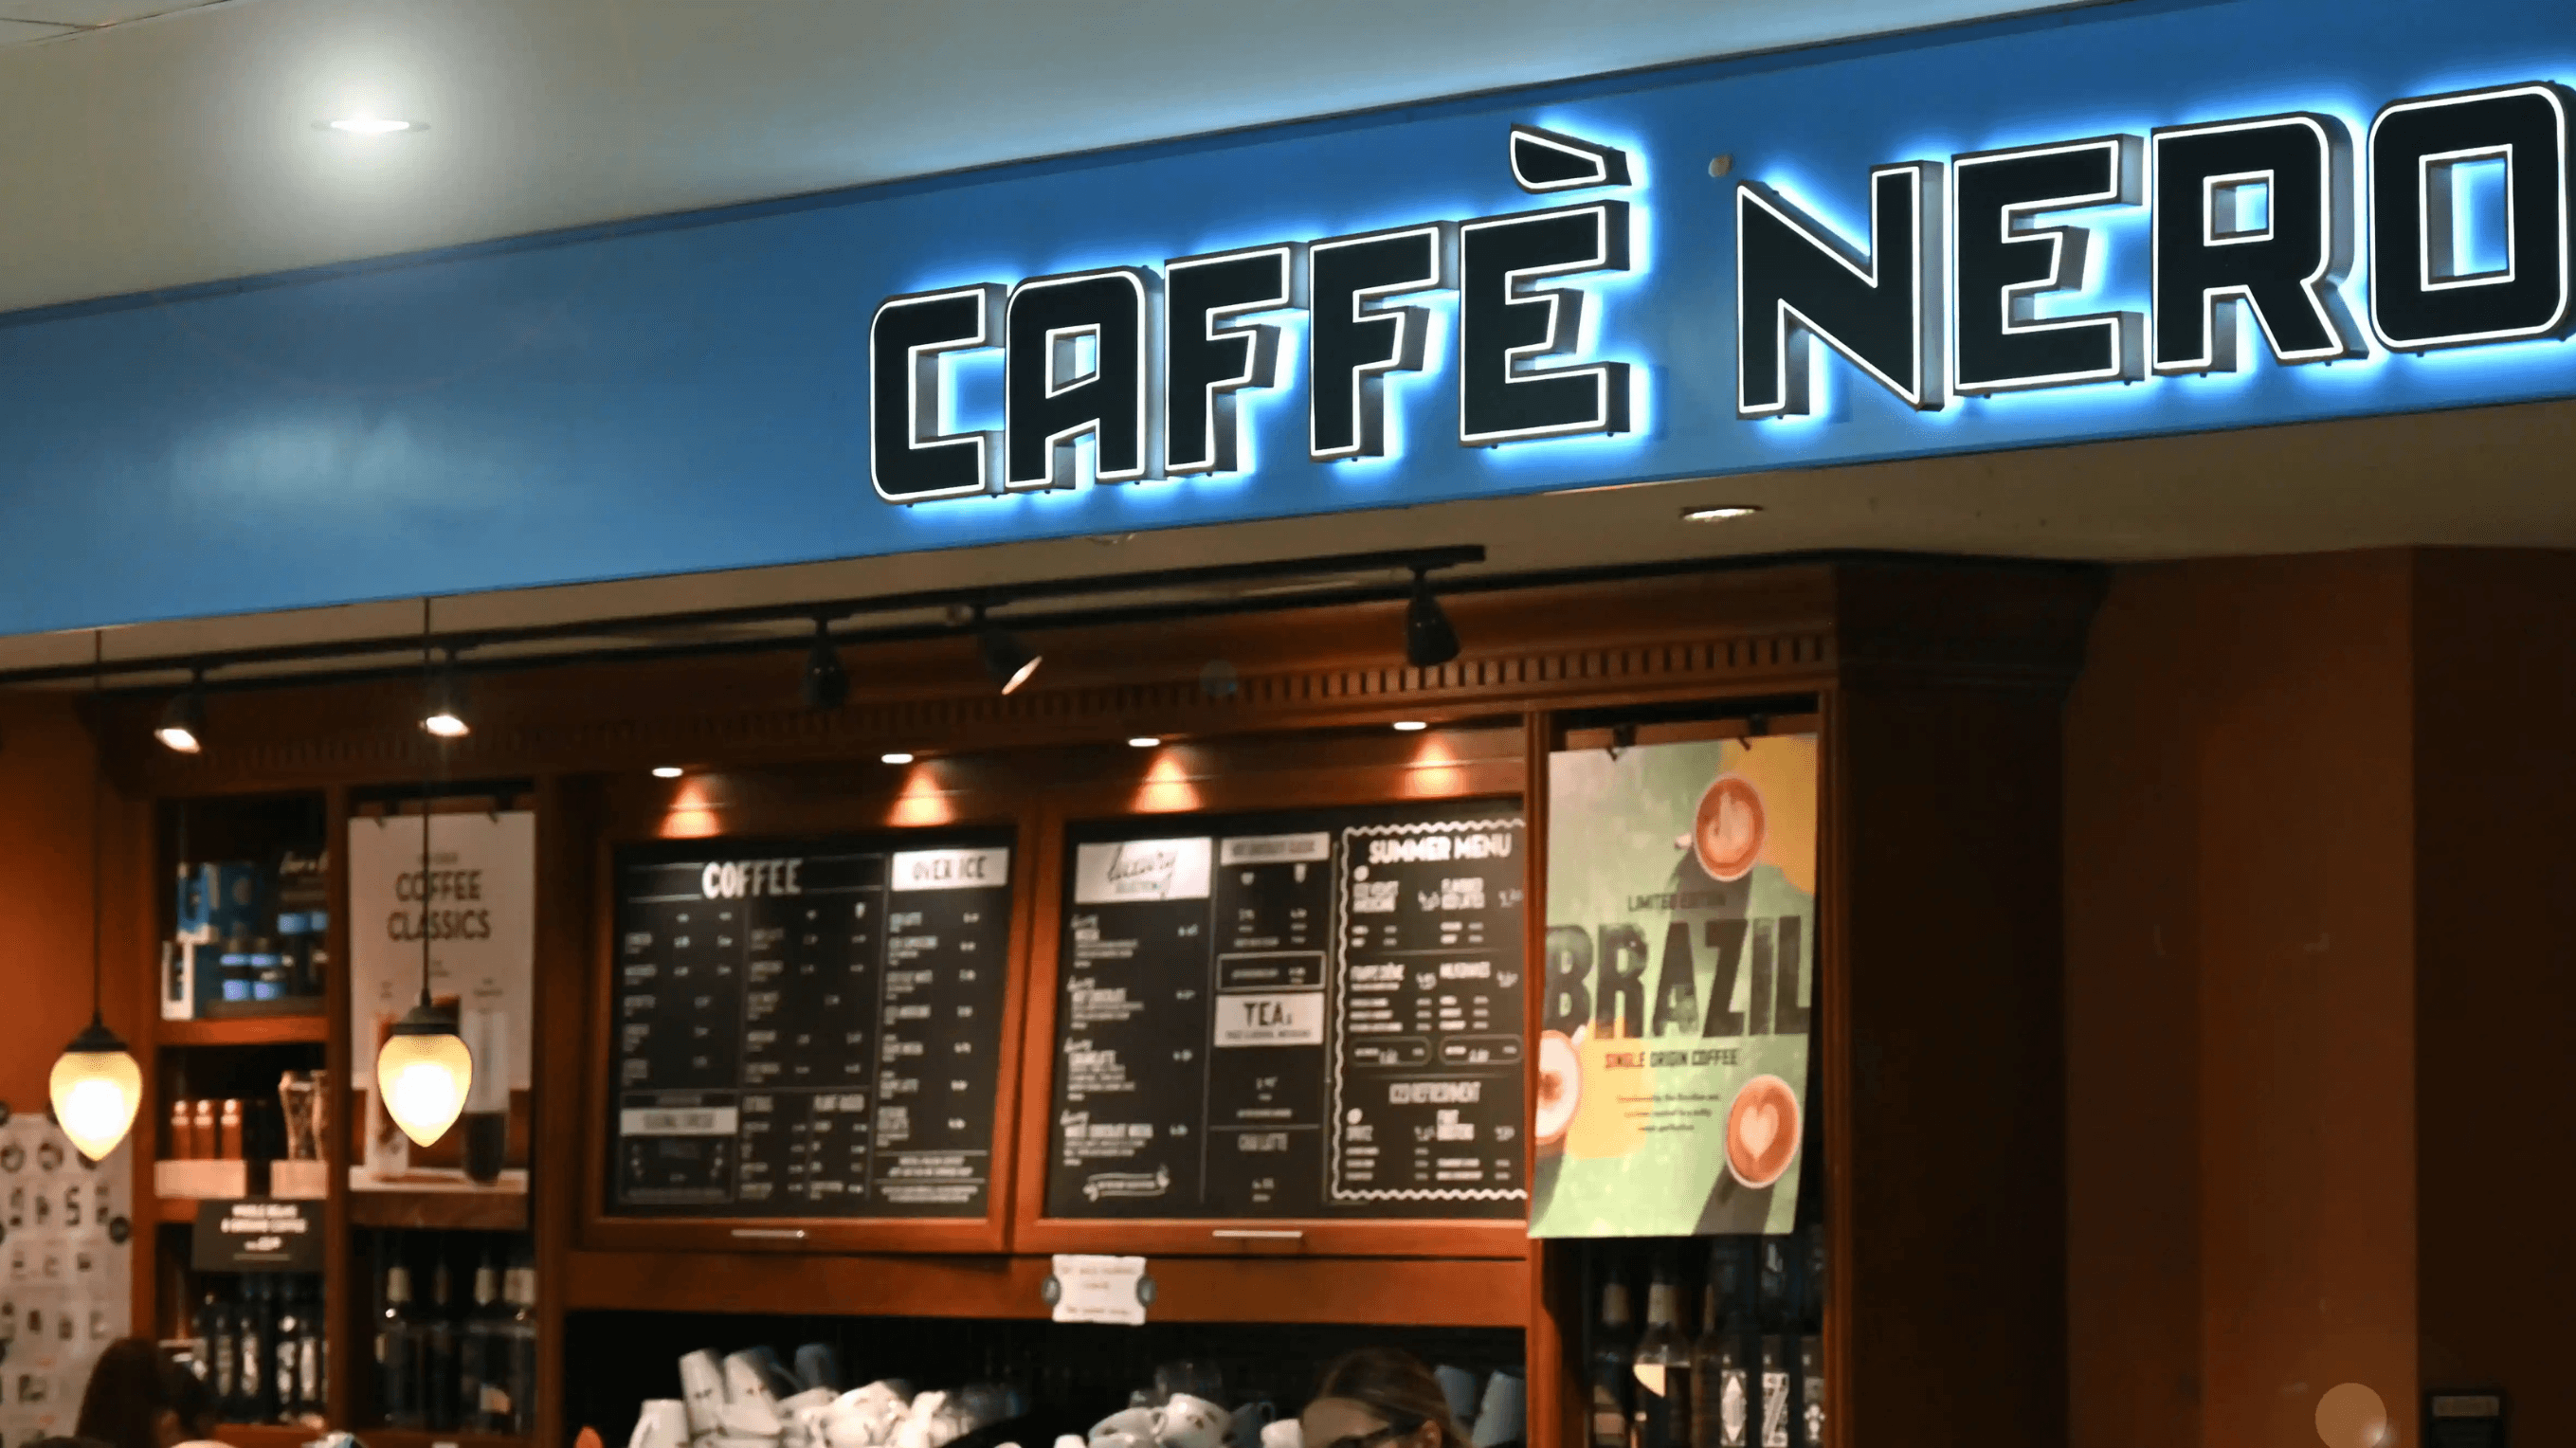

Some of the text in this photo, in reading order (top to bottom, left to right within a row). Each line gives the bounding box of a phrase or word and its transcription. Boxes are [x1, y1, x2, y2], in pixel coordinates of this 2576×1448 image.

[870, 81, 2576, 506] CAFFÈ NERO
[1368, 832, 1513, 864] SUMMER MENU
[701, 857, 804, 898] COFFEE
[959, 855, 988, 878] ICE
[396, 869, 482, 902] COFFEE
[387, 909, 492, 941] CLASSICS
[1544, 914, 1810, 1041] BRAZIL
[1691, 1047, 1739, 1066] COFFEE
